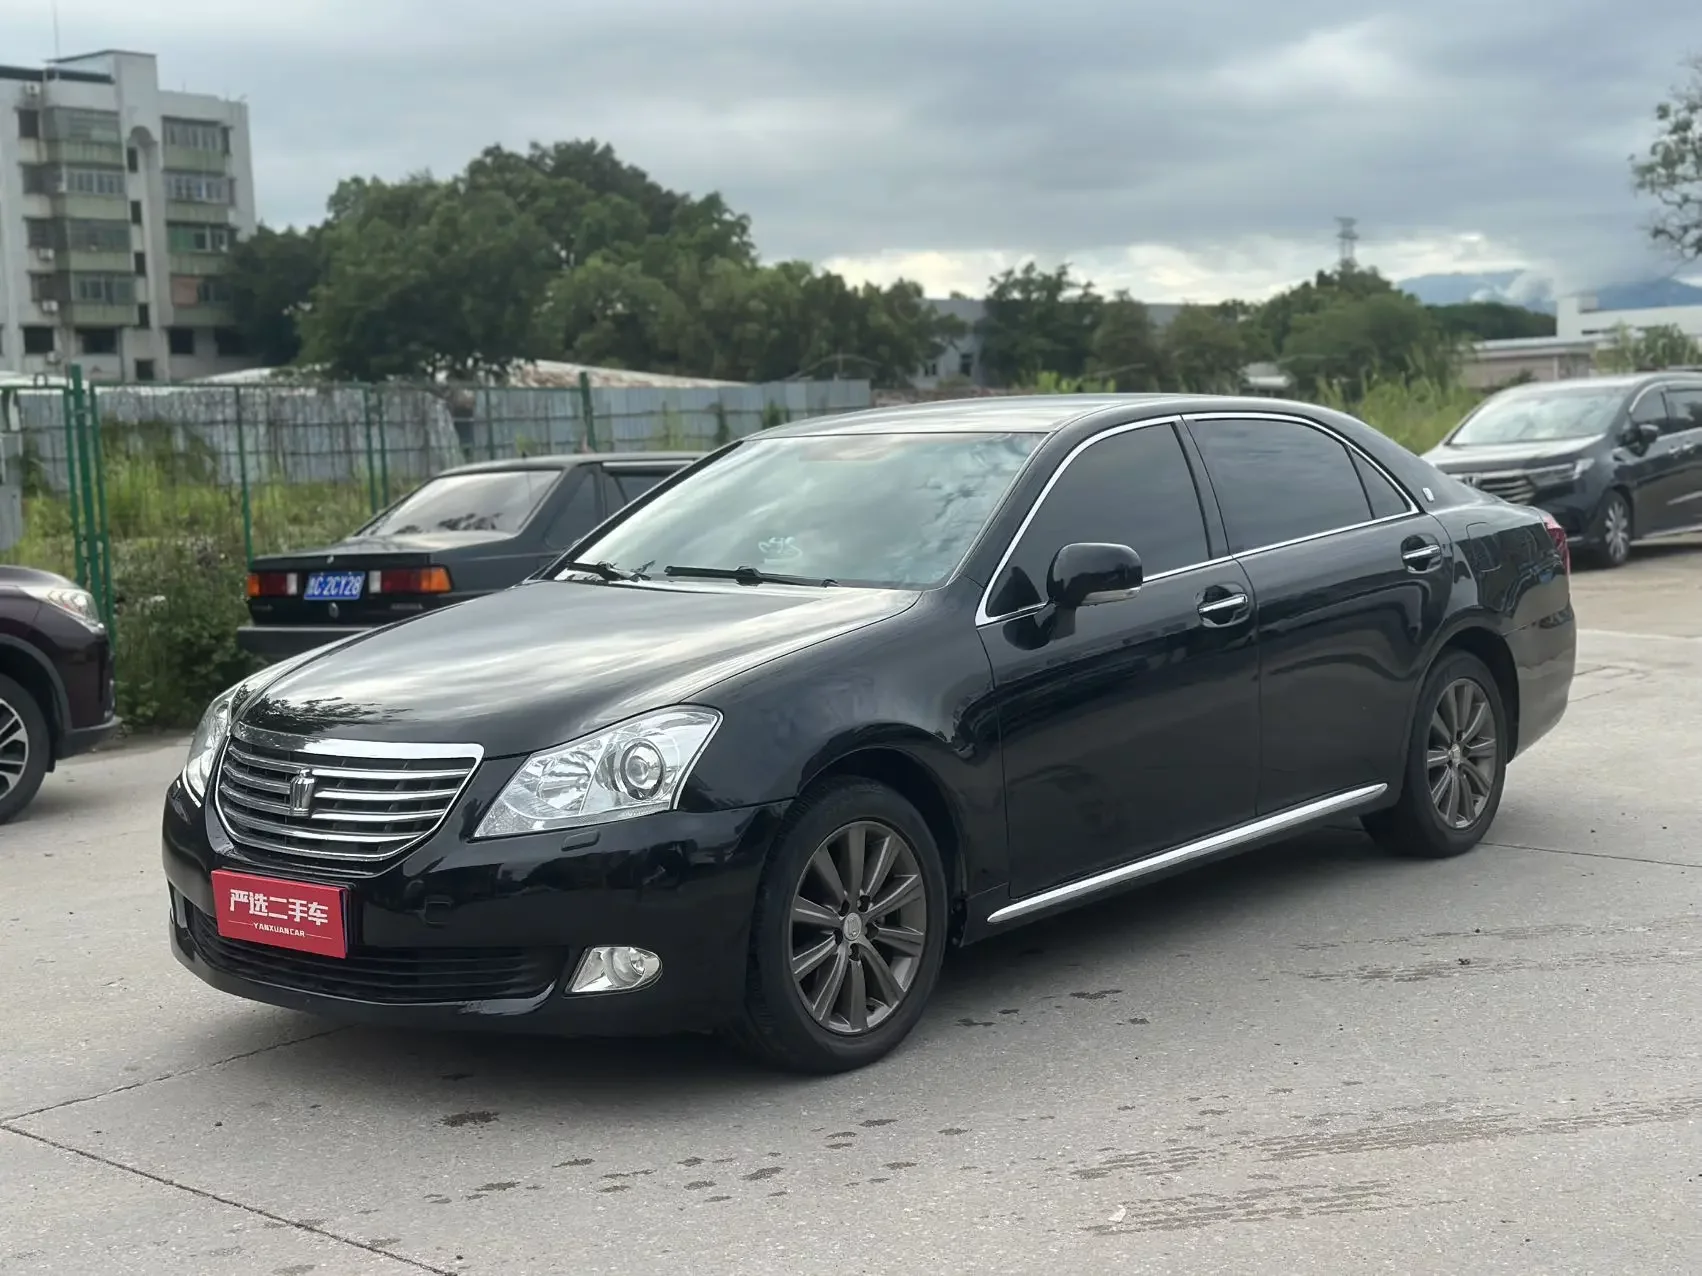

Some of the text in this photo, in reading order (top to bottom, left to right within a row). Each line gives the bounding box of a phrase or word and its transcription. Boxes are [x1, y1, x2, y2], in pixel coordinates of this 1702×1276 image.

[230, 889, 328, 925] 严选二手车
[253, 922, 305, 936] YANXUANCAR
